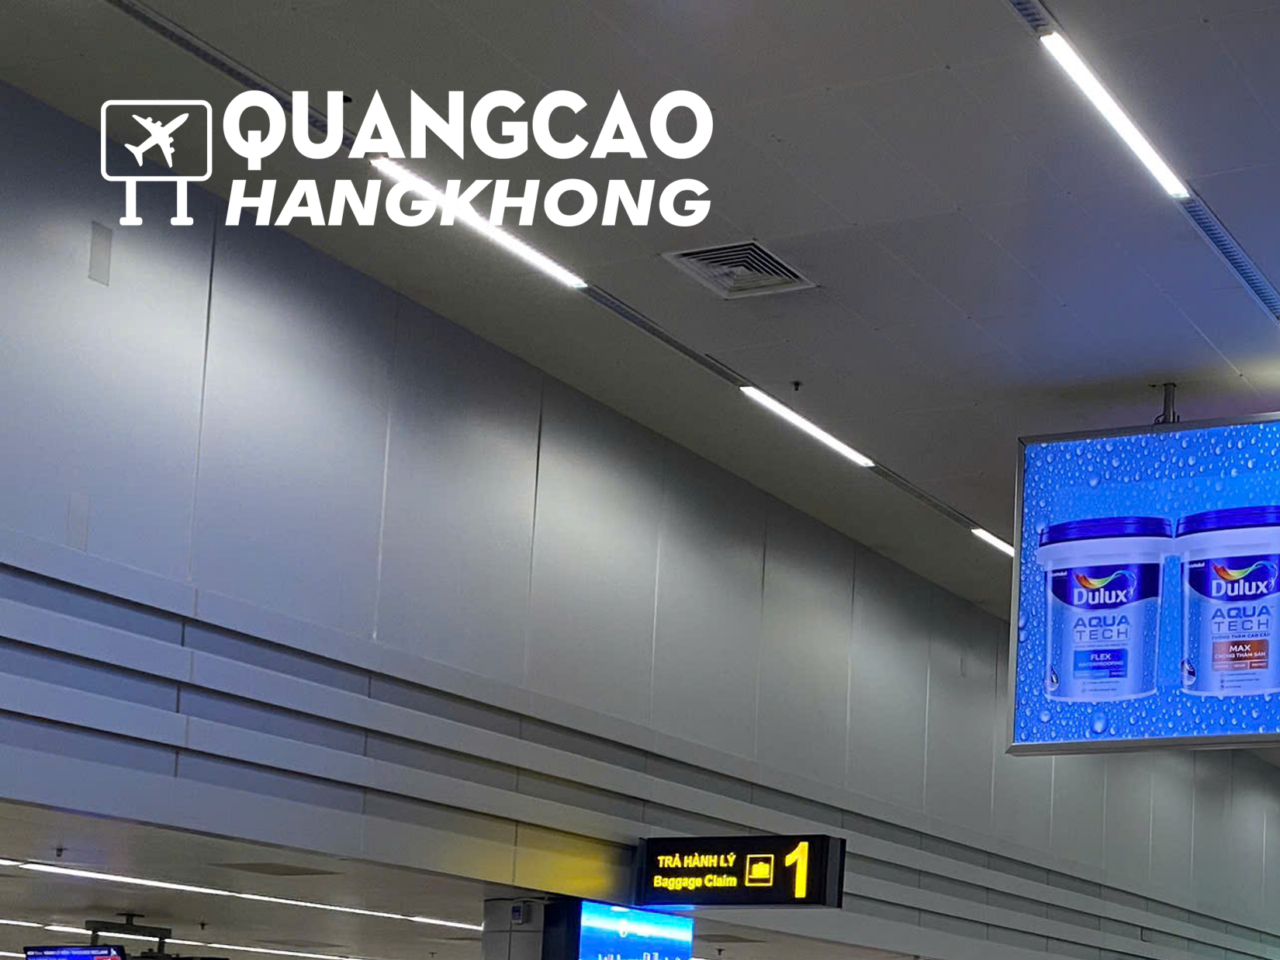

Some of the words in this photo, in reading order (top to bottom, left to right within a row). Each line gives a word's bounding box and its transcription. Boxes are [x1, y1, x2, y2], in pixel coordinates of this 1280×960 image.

[1211, 579, 1269, 597] Dulux
[1073, 587, 1128, 605] Dulux
[1211, 605, 1272, 620] AQUA
[1073, 615, 1131, 629] AQUA
[1213, 618, 1269, 632] TECH
[1075, 628, 1129, 641] TECH
[1229, 644, 1252, 653] MAX
[657, 853, 681, 868] TRẢ
[684, 852, 717, 868] HÀNH
[720, 852, 736, 867] LÝ
[785, 841, 809, 898] 1
[653, 875, 702, 890] Baggage
[704, 874, 738, 887] Claim
